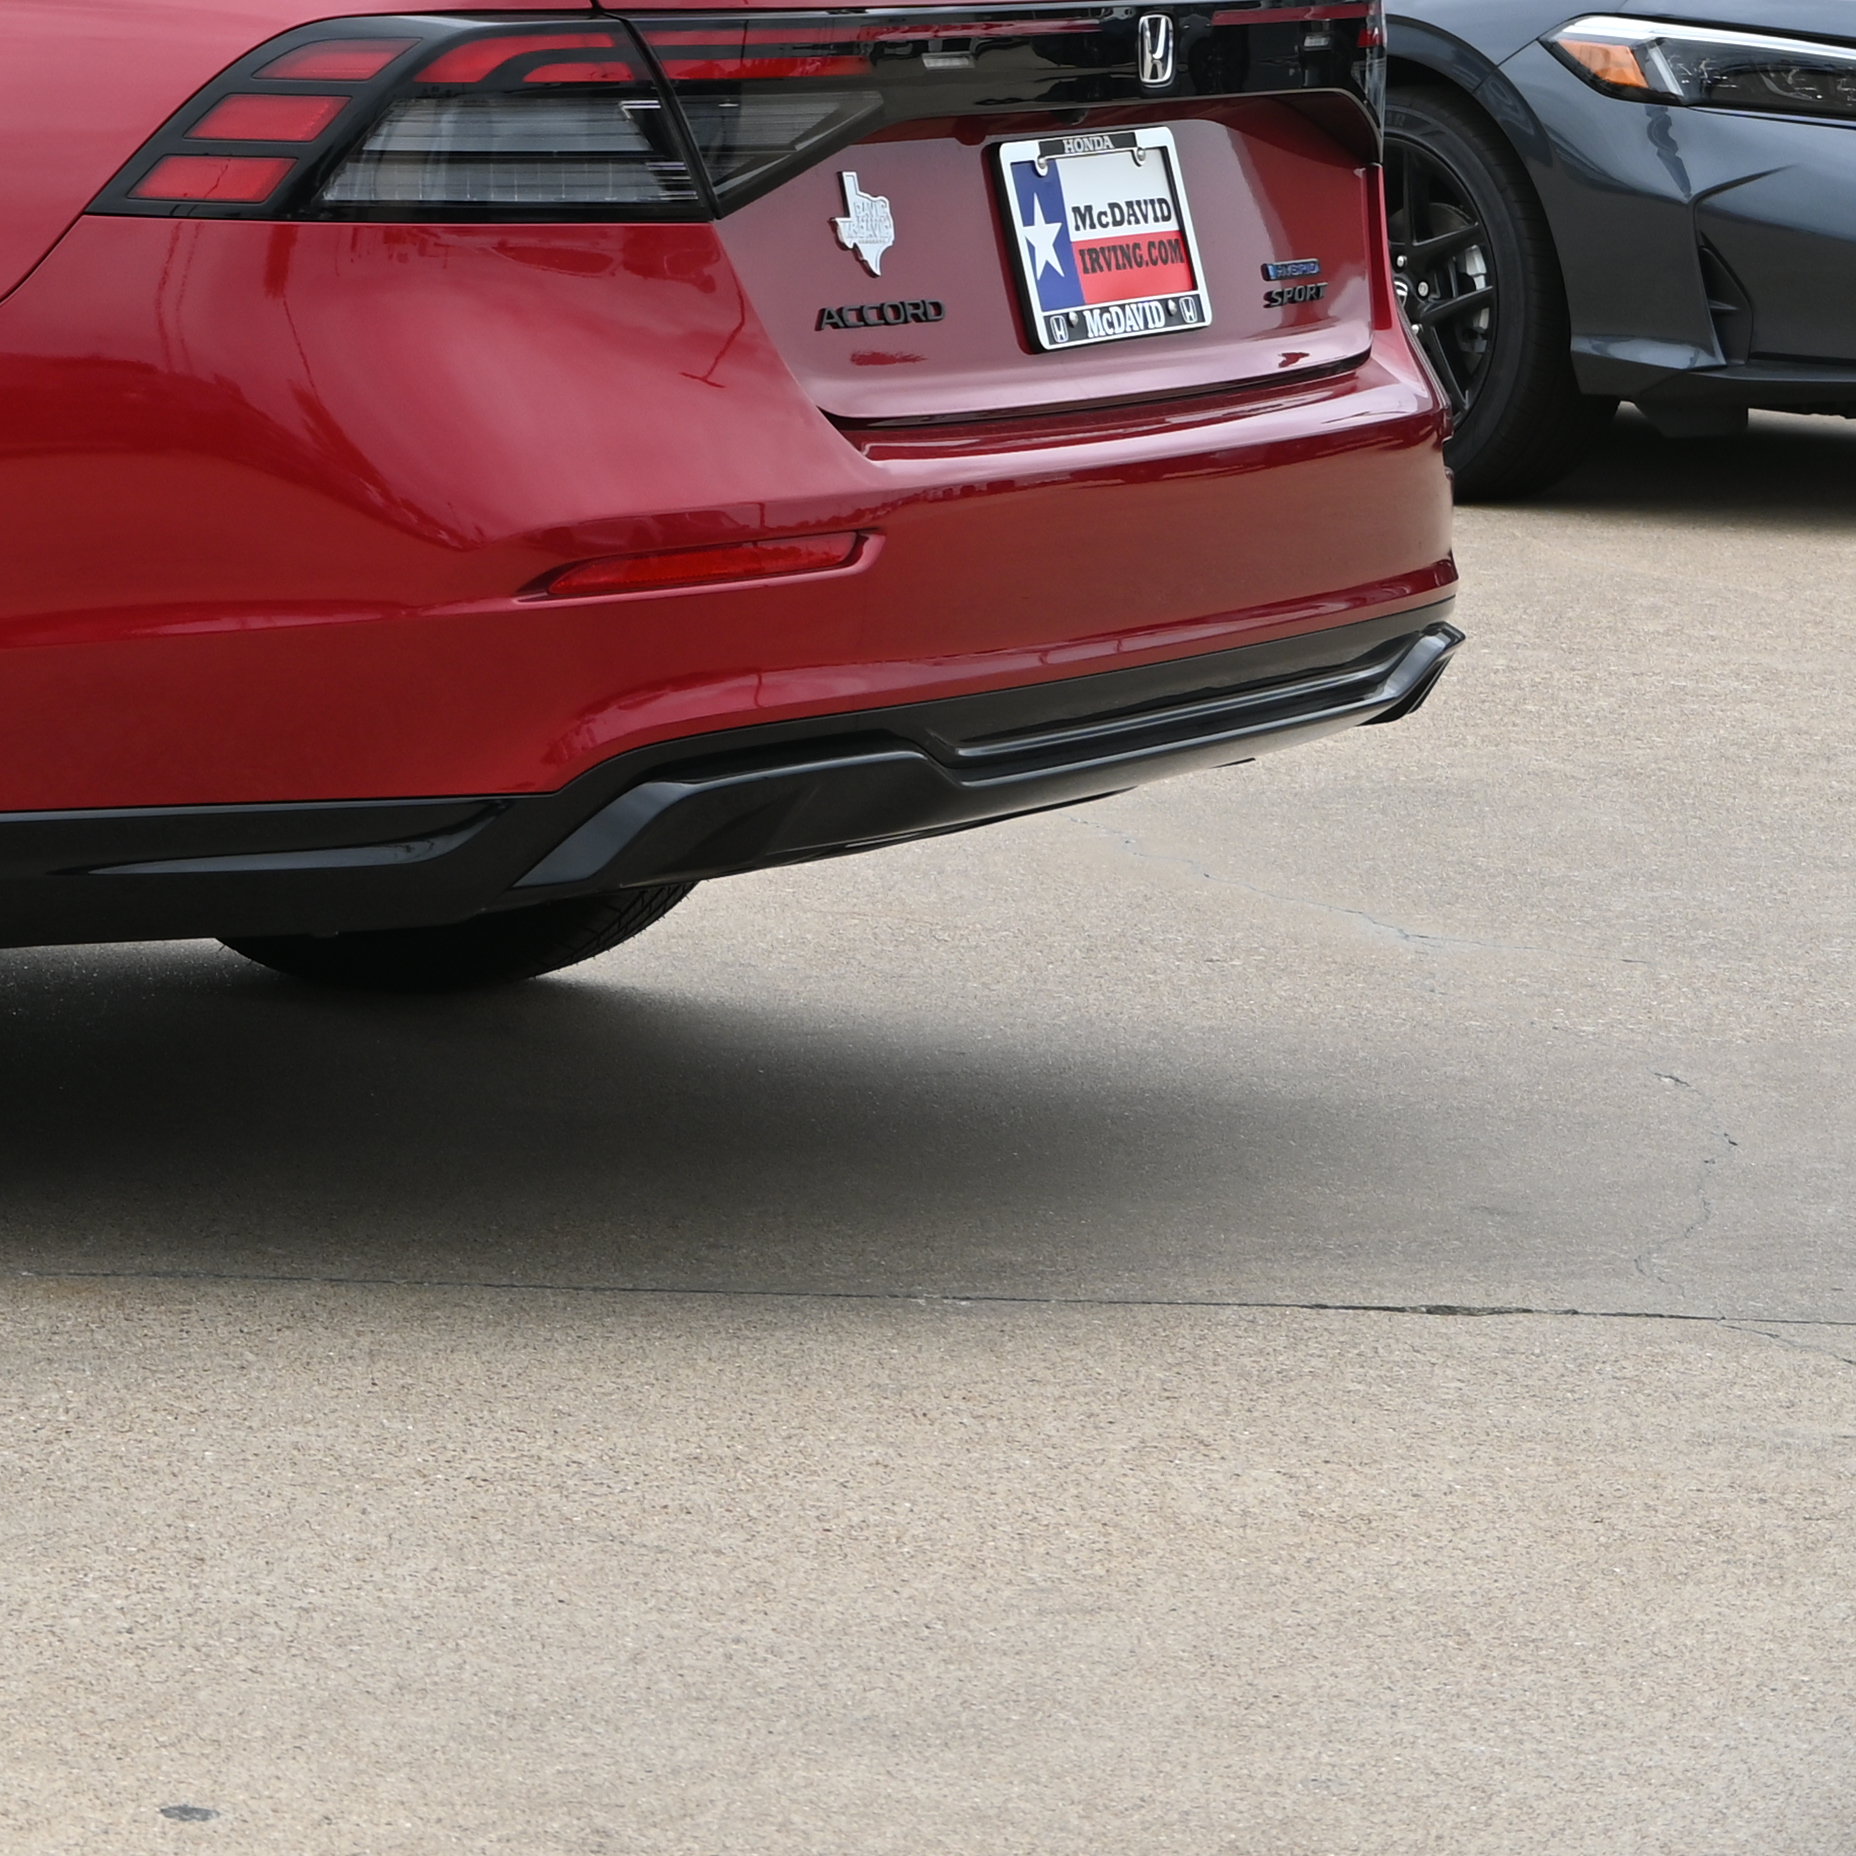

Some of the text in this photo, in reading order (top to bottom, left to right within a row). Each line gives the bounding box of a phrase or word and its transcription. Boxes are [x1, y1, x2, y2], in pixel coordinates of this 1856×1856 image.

[1062, 135, 1114, 154] HONDA
[1071, 197, 1173, 232] McDAVID
[1078, 238, 1186, 275] IRVING.COM
[1269, 281, 1329, 307] SPORT
[816, 298, 947, 331] ACCORD
[1081, 300, 1166, 339] McDAVID
